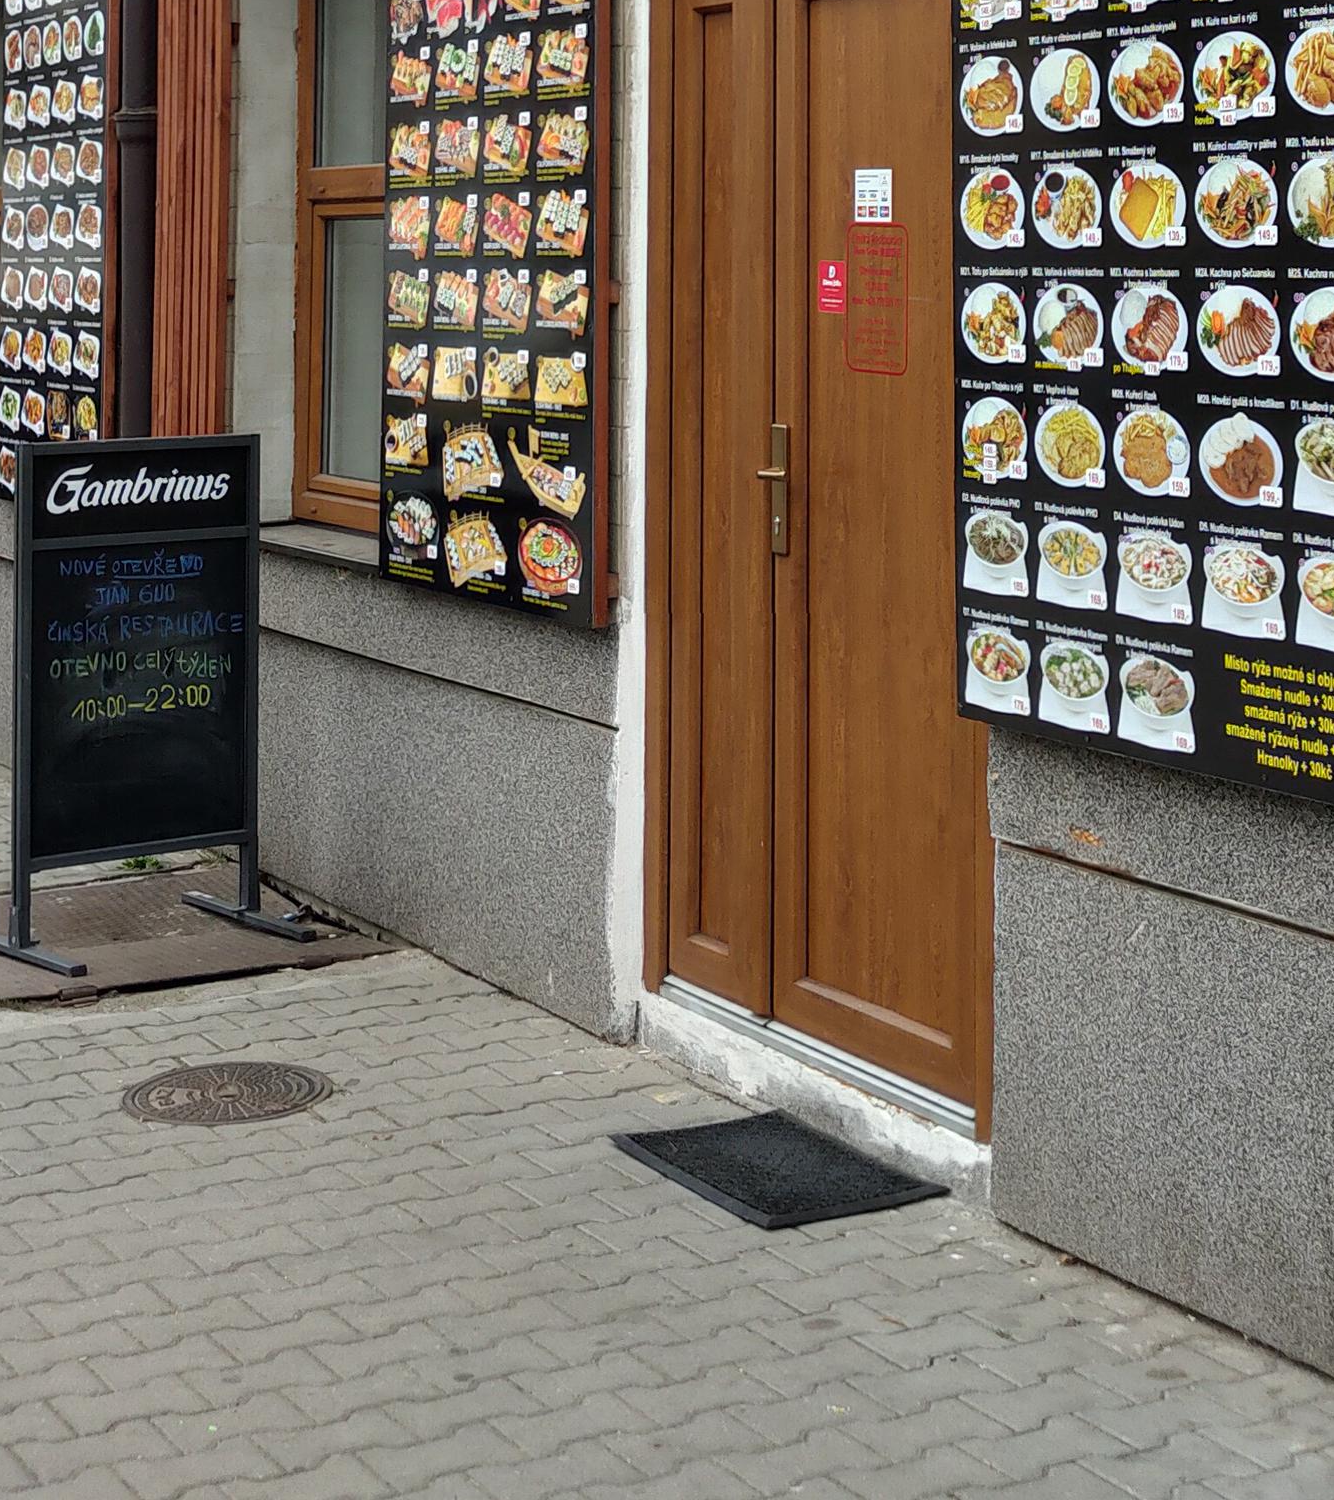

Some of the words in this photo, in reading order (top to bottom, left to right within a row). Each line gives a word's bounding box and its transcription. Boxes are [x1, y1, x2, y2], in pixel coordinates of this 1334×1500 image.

[46, 463, 231, 515] Gambrinus
[60, 553, 106, 577] NOVÉ
[139, 584, 176, 603] GUO
[120, 610, 244, 642] RESTAURACE
[1251, 659, 1270, 678] rýže
[1307, 669, 1315, 684] si
[1284, 690, 1310, 707] nudle
[1287, 711, 1307, 731] rýže
[1302, 738, 1328, 756] nudle
[1257, 749, 1299, 776] Hranolky
[1310, 761, 1333, 781] 30kč
